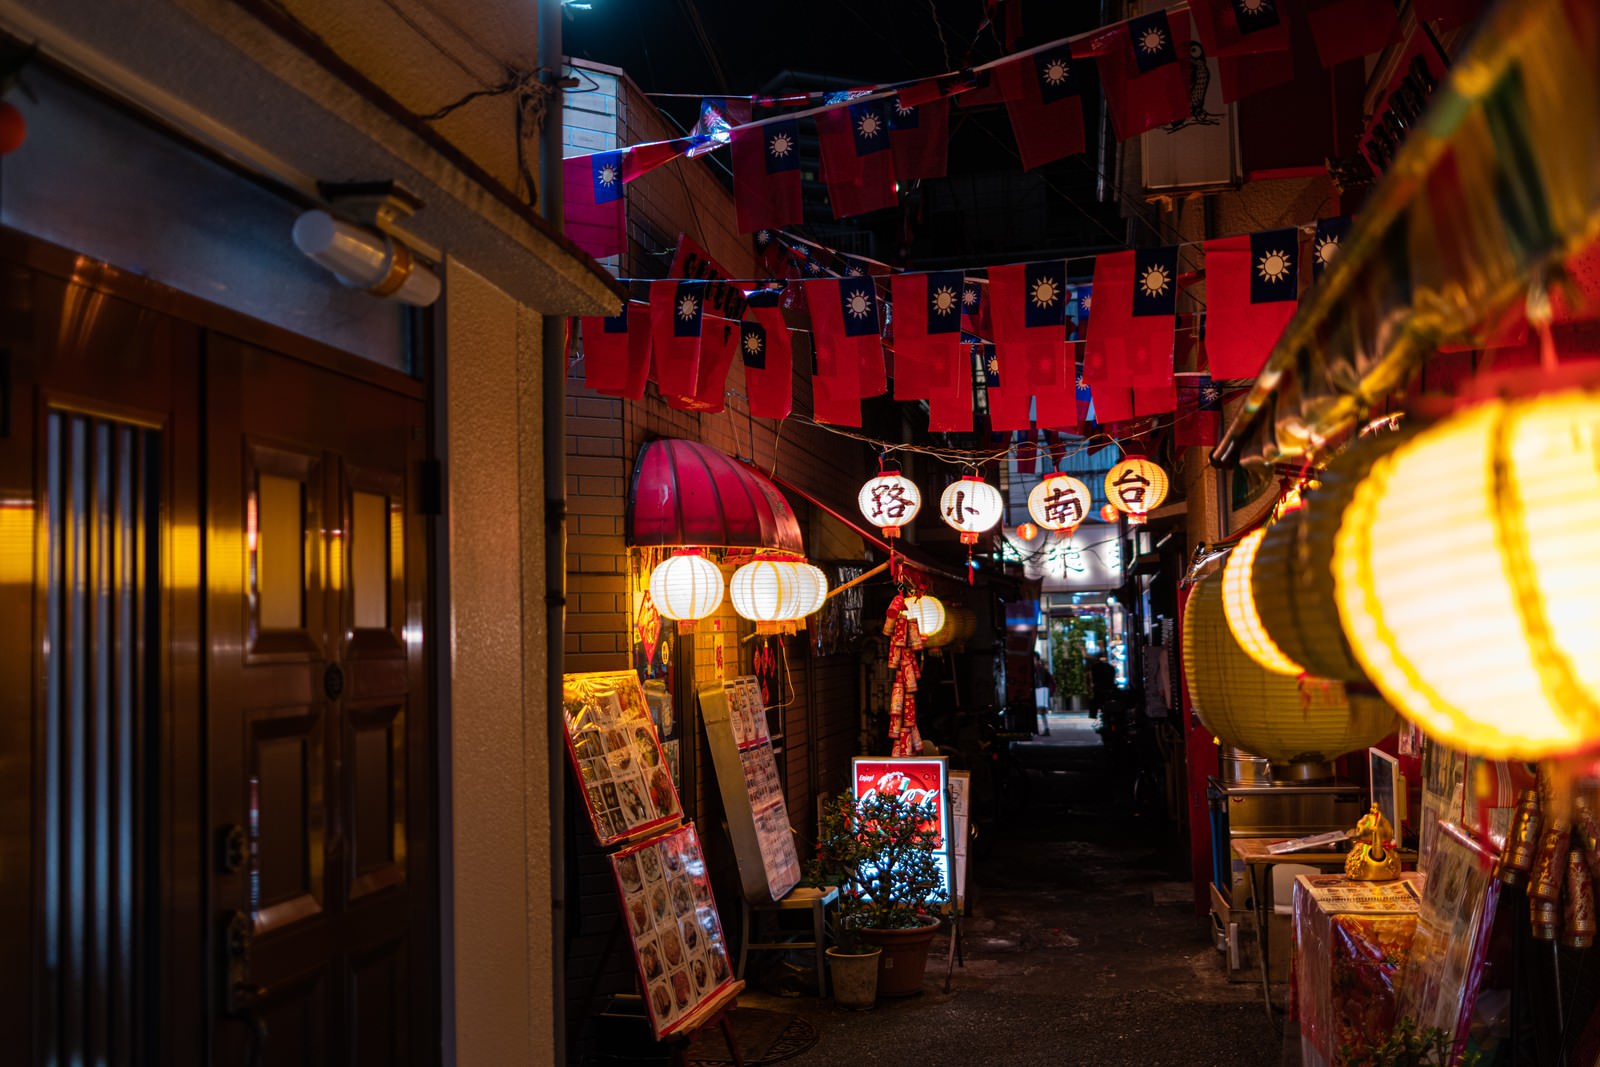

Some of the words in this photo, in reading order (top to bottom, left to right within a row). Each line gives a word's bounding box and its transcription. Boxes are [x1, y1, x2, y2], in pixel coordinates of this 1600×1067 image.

[871, 483, 915, 519] 路
[1112, 468, 1151, 504] 台
[945, 490, 980, 525] 小
[1043, 487, 1083, 524] 南
